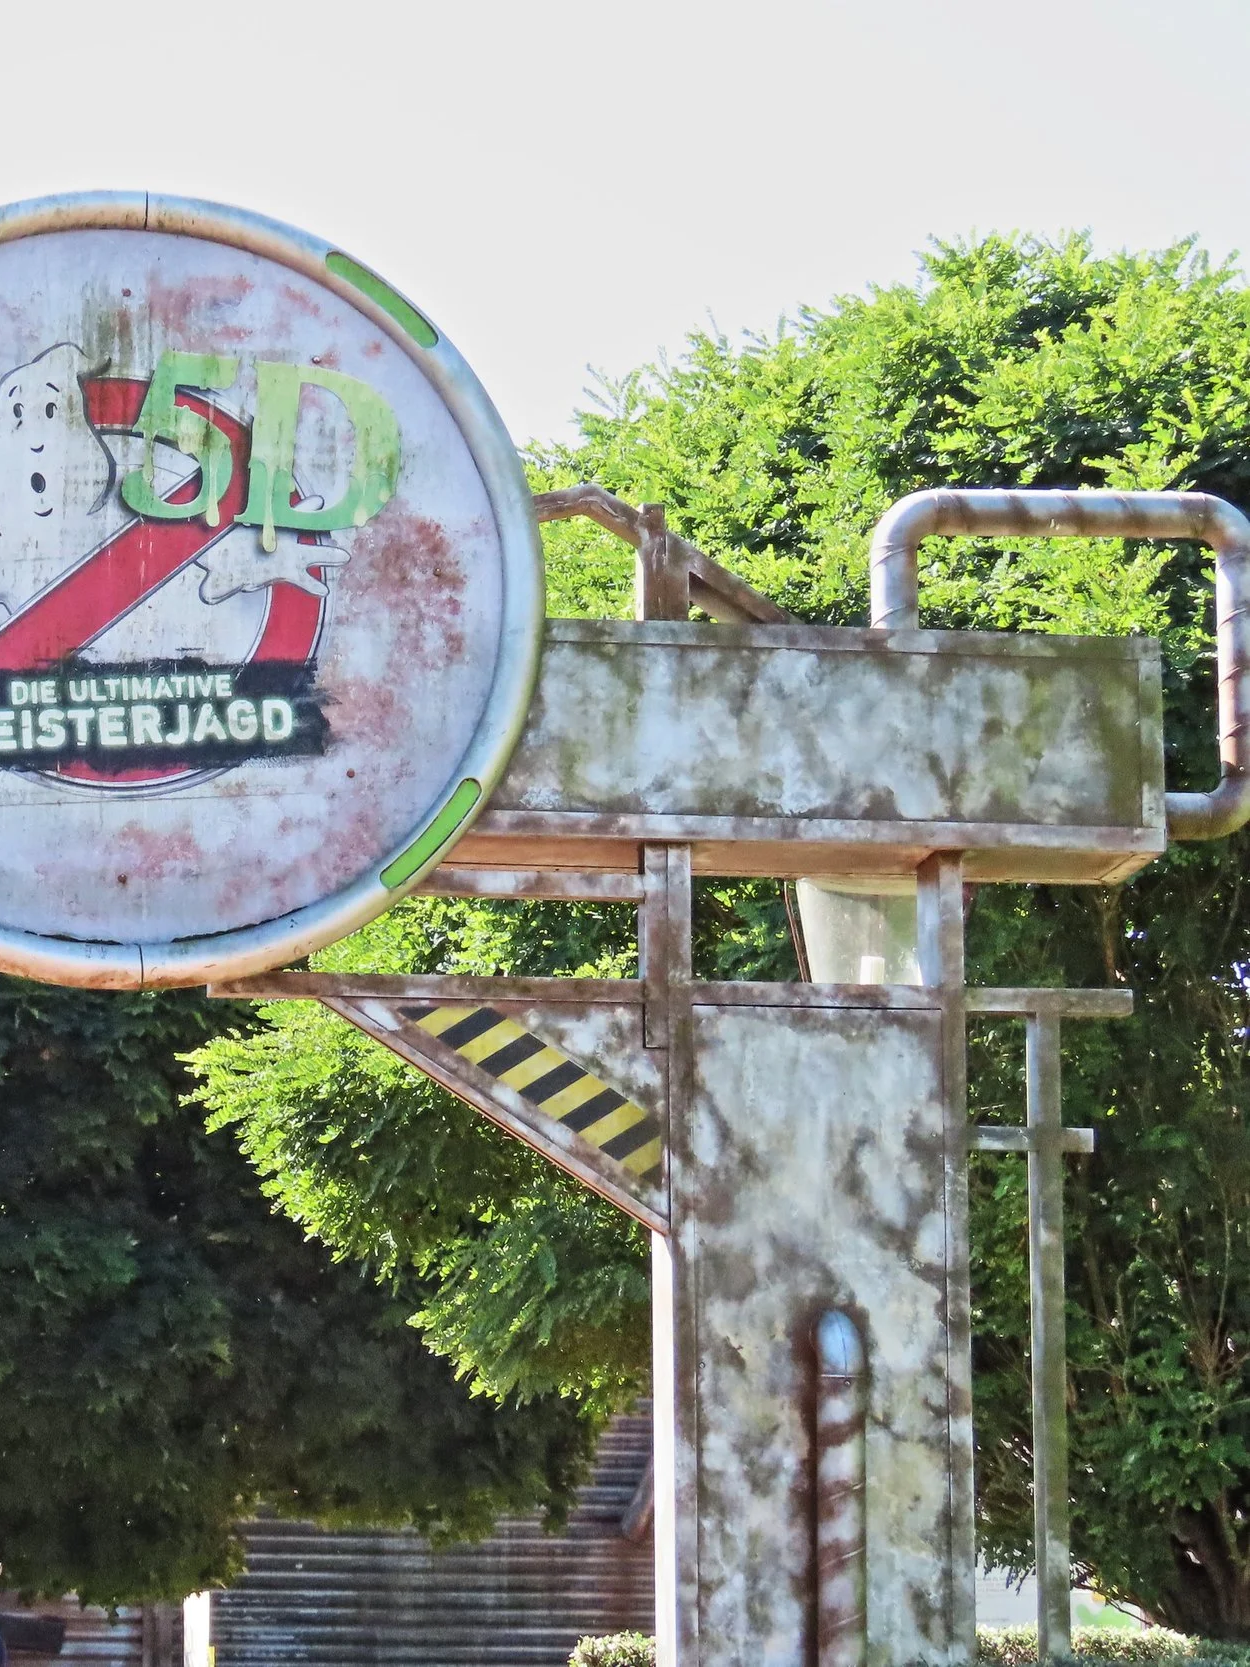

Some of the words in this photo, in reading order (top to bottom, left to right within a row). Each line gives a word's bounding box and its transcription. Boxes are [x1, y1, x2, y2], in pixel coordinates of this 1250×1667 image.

[121, 349, 400, 550] 5D
[10, 680, 58, 705] DIE
[68, 674, 233, 703] ULTIMATIVE
